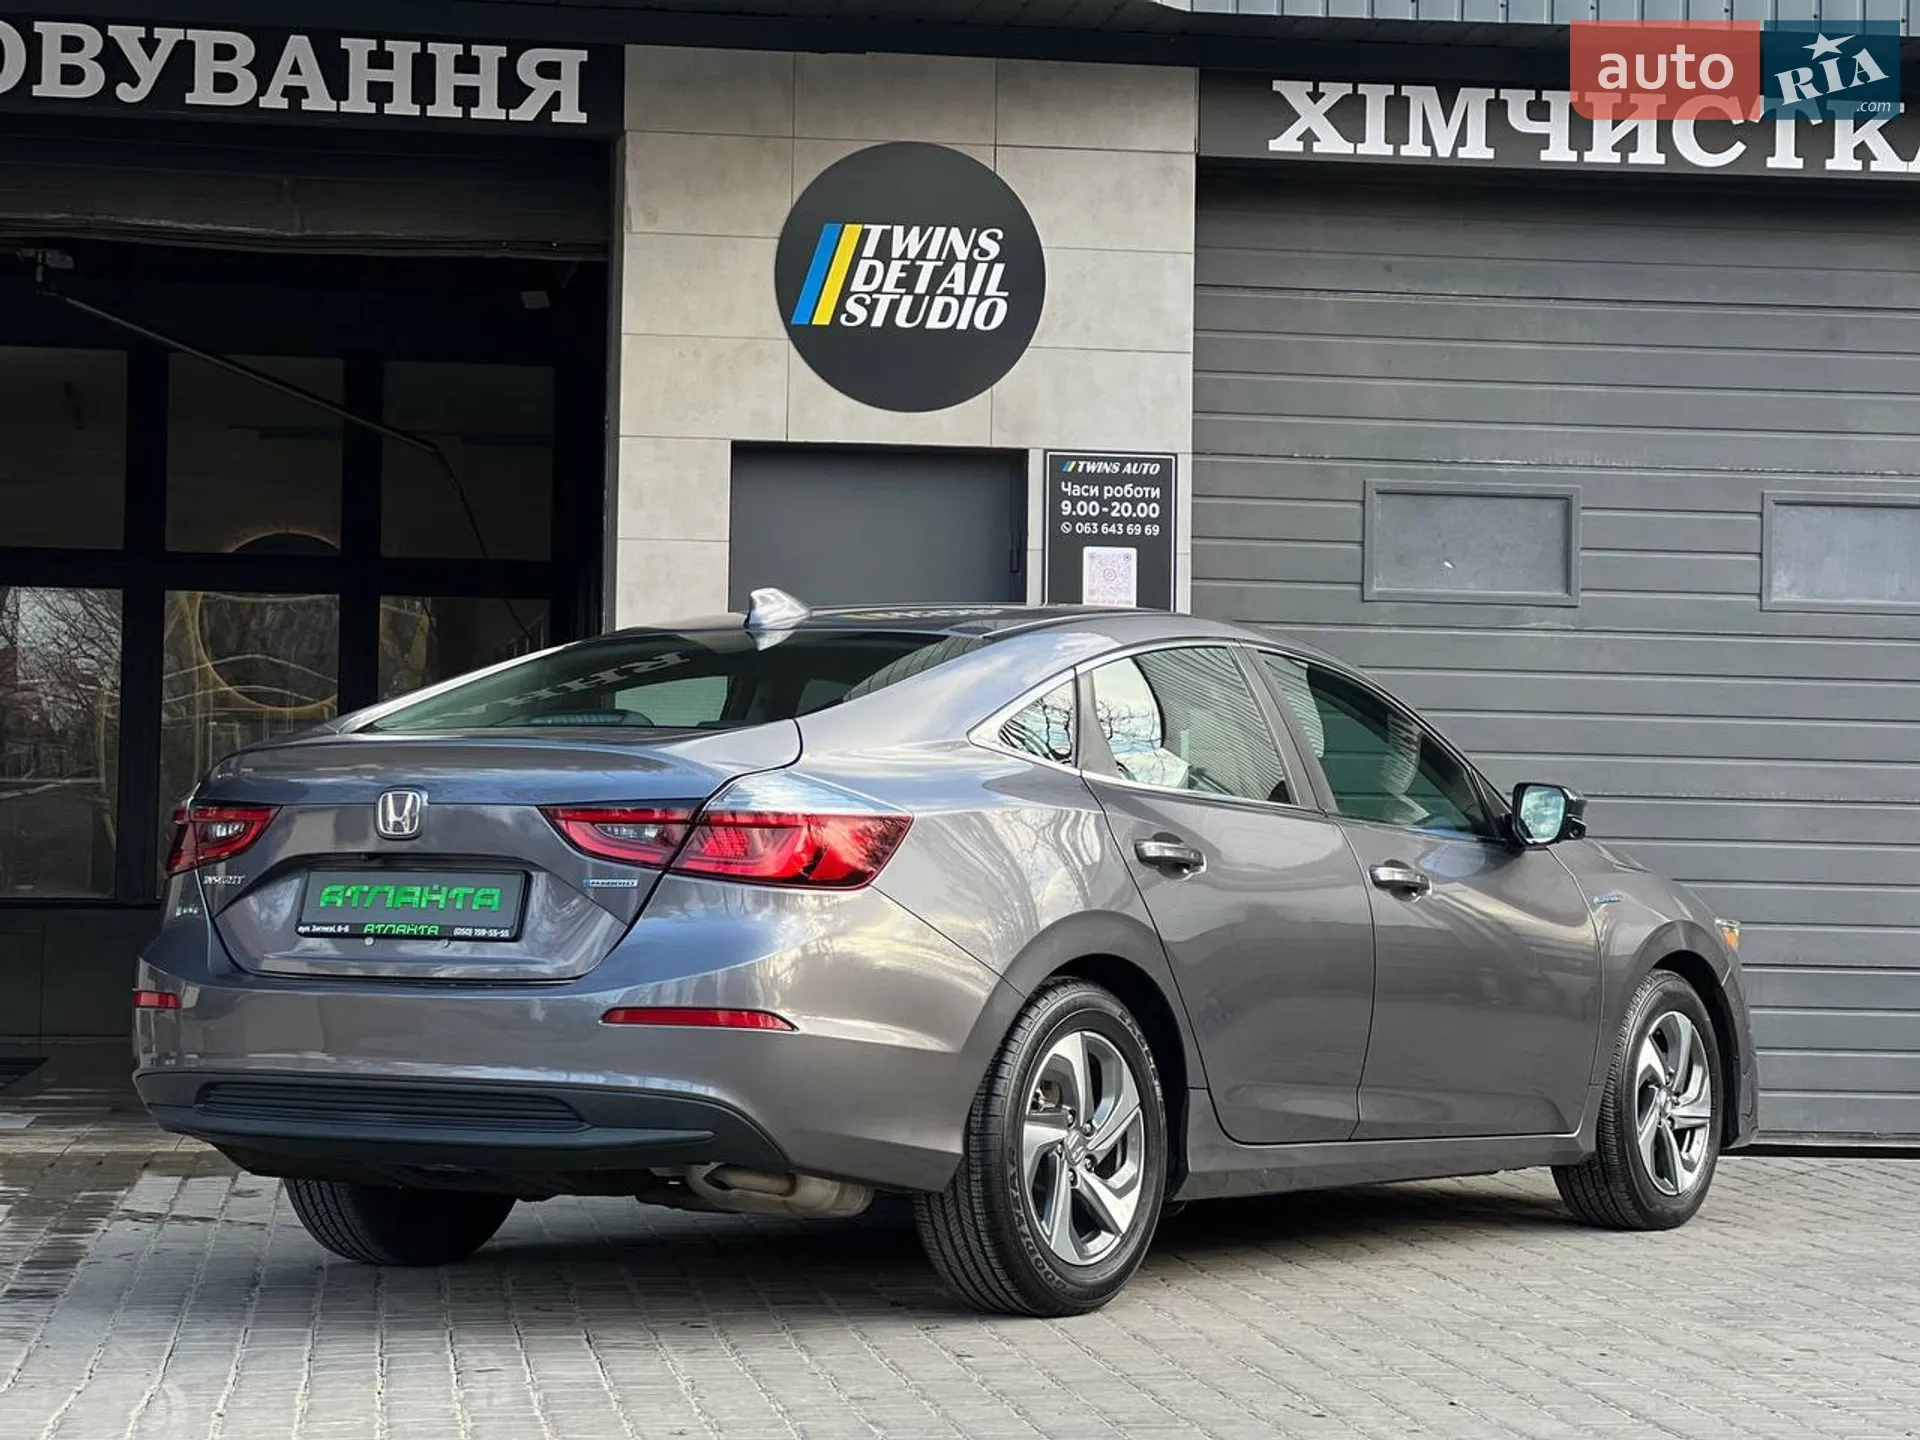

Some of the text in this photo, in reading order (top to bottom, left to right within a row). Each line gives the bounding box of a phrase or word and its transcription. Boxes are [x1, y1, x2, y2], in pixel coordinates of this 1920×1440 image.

[1269, 80, 1920, 173] ХІМЧИСТК
[861, 223, 1003, 262] TWINS
[850, 259, 1009, 297] DETAIL
[839, 293, 1008, 331] STUDIO
[1077, 461, 1160, 475] TWINS AUTO
[1061, 482, 1160, 499] Часи роботи
[1075, 522, 1160, 536] 063 643 69 69
